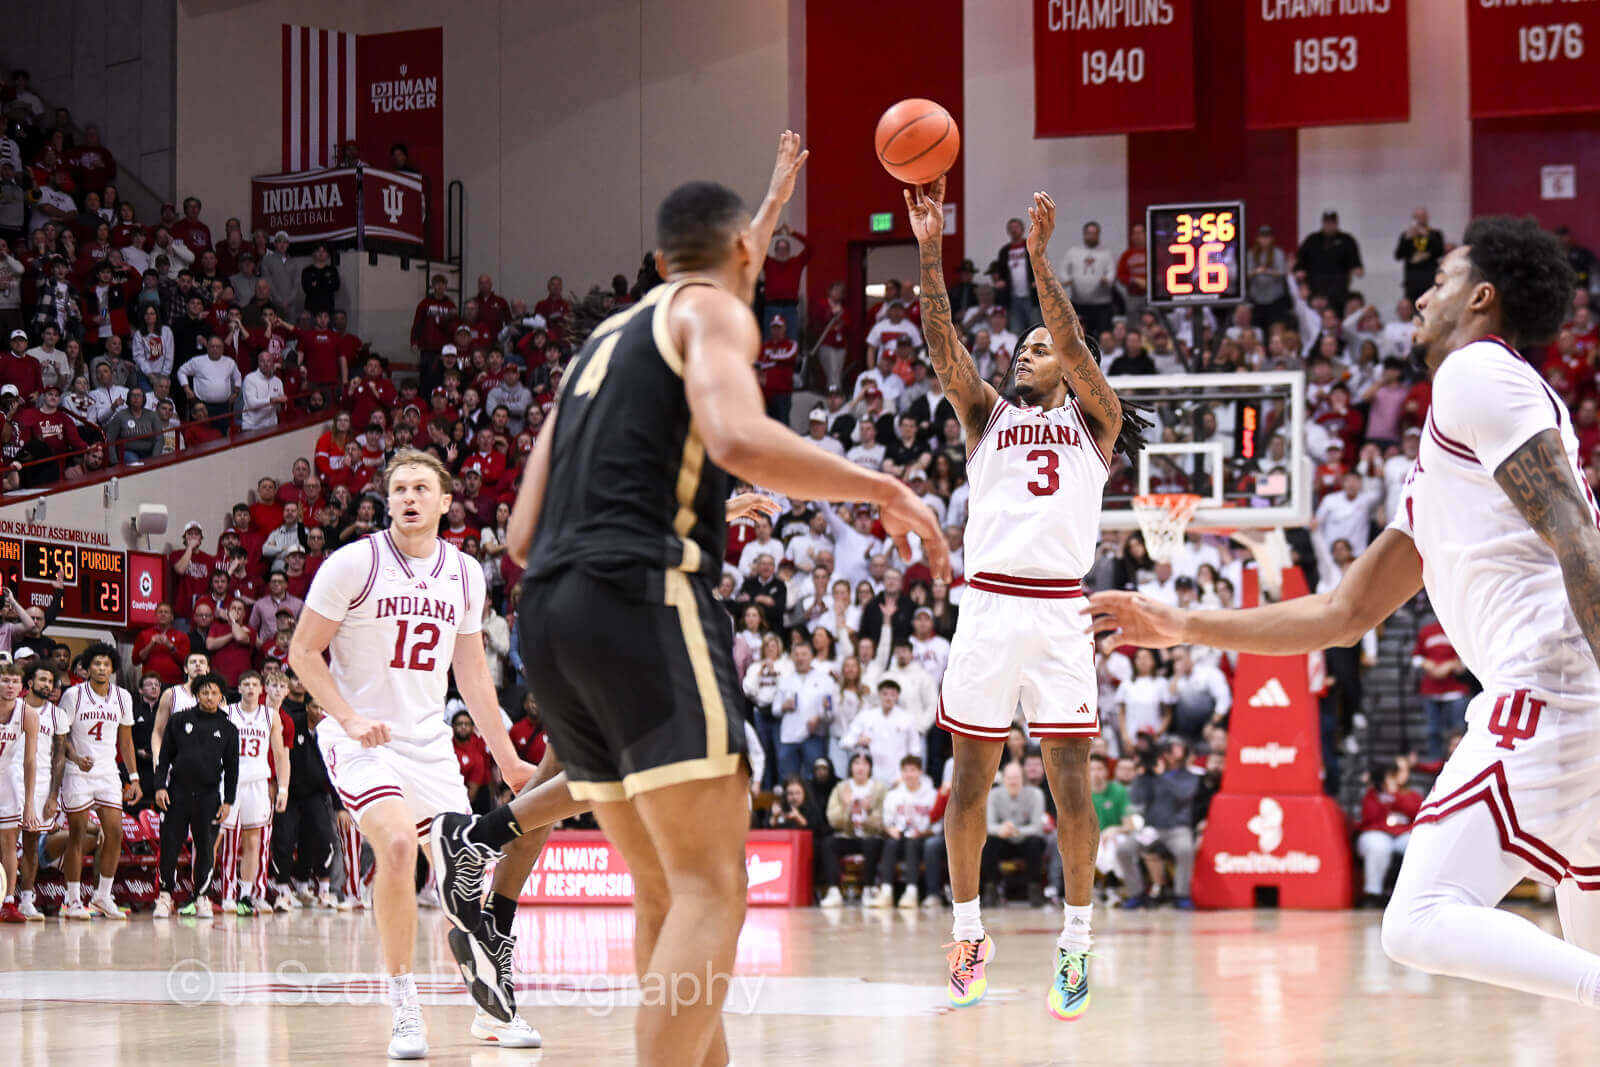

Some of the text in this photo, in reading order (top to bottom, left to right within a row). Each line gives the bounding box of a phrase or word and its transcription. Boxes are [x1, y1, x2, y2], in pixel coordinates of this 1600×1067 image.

[1048, 0, 1174, 32] CHAMPIONS
[1294, 36, 1358, 75] 1953
[1519, 22, 1584, 63] 1976
[1082, 47, 1145, 85] 1940
[371, 93, 437, 114] TUCKER
[262, 183, 344, 215] INDIANA
[270, 210, 336, 227] BASKETBALL
[1176, 211, 1236, 243] 3:56
[1166, 242, 1229, 294] 26
[573, 329, 623, 400] 4
[996, 424, 1083, 451] INDIANA
[1026, 449, 1060, 497] 3
[0, 520, 13, 533] ON
[48, 527, 90, 545] ASSEMBLY
[90, 532, 111, 546] HALL
[39, 546, 74, 580] 3:56
[81, 551, 121, 573] PURDUE
[100, 582, 120, 612] 23
[375, 595, 456, 627] INDIANA
[390, 619, 441, 672] 12
[80, 711, 118, 722] INDIANA
[87, 720, 104, 741] 4
[240, 737, 261, 757] 13
[543, 847, 608, 871] ALWAYS
